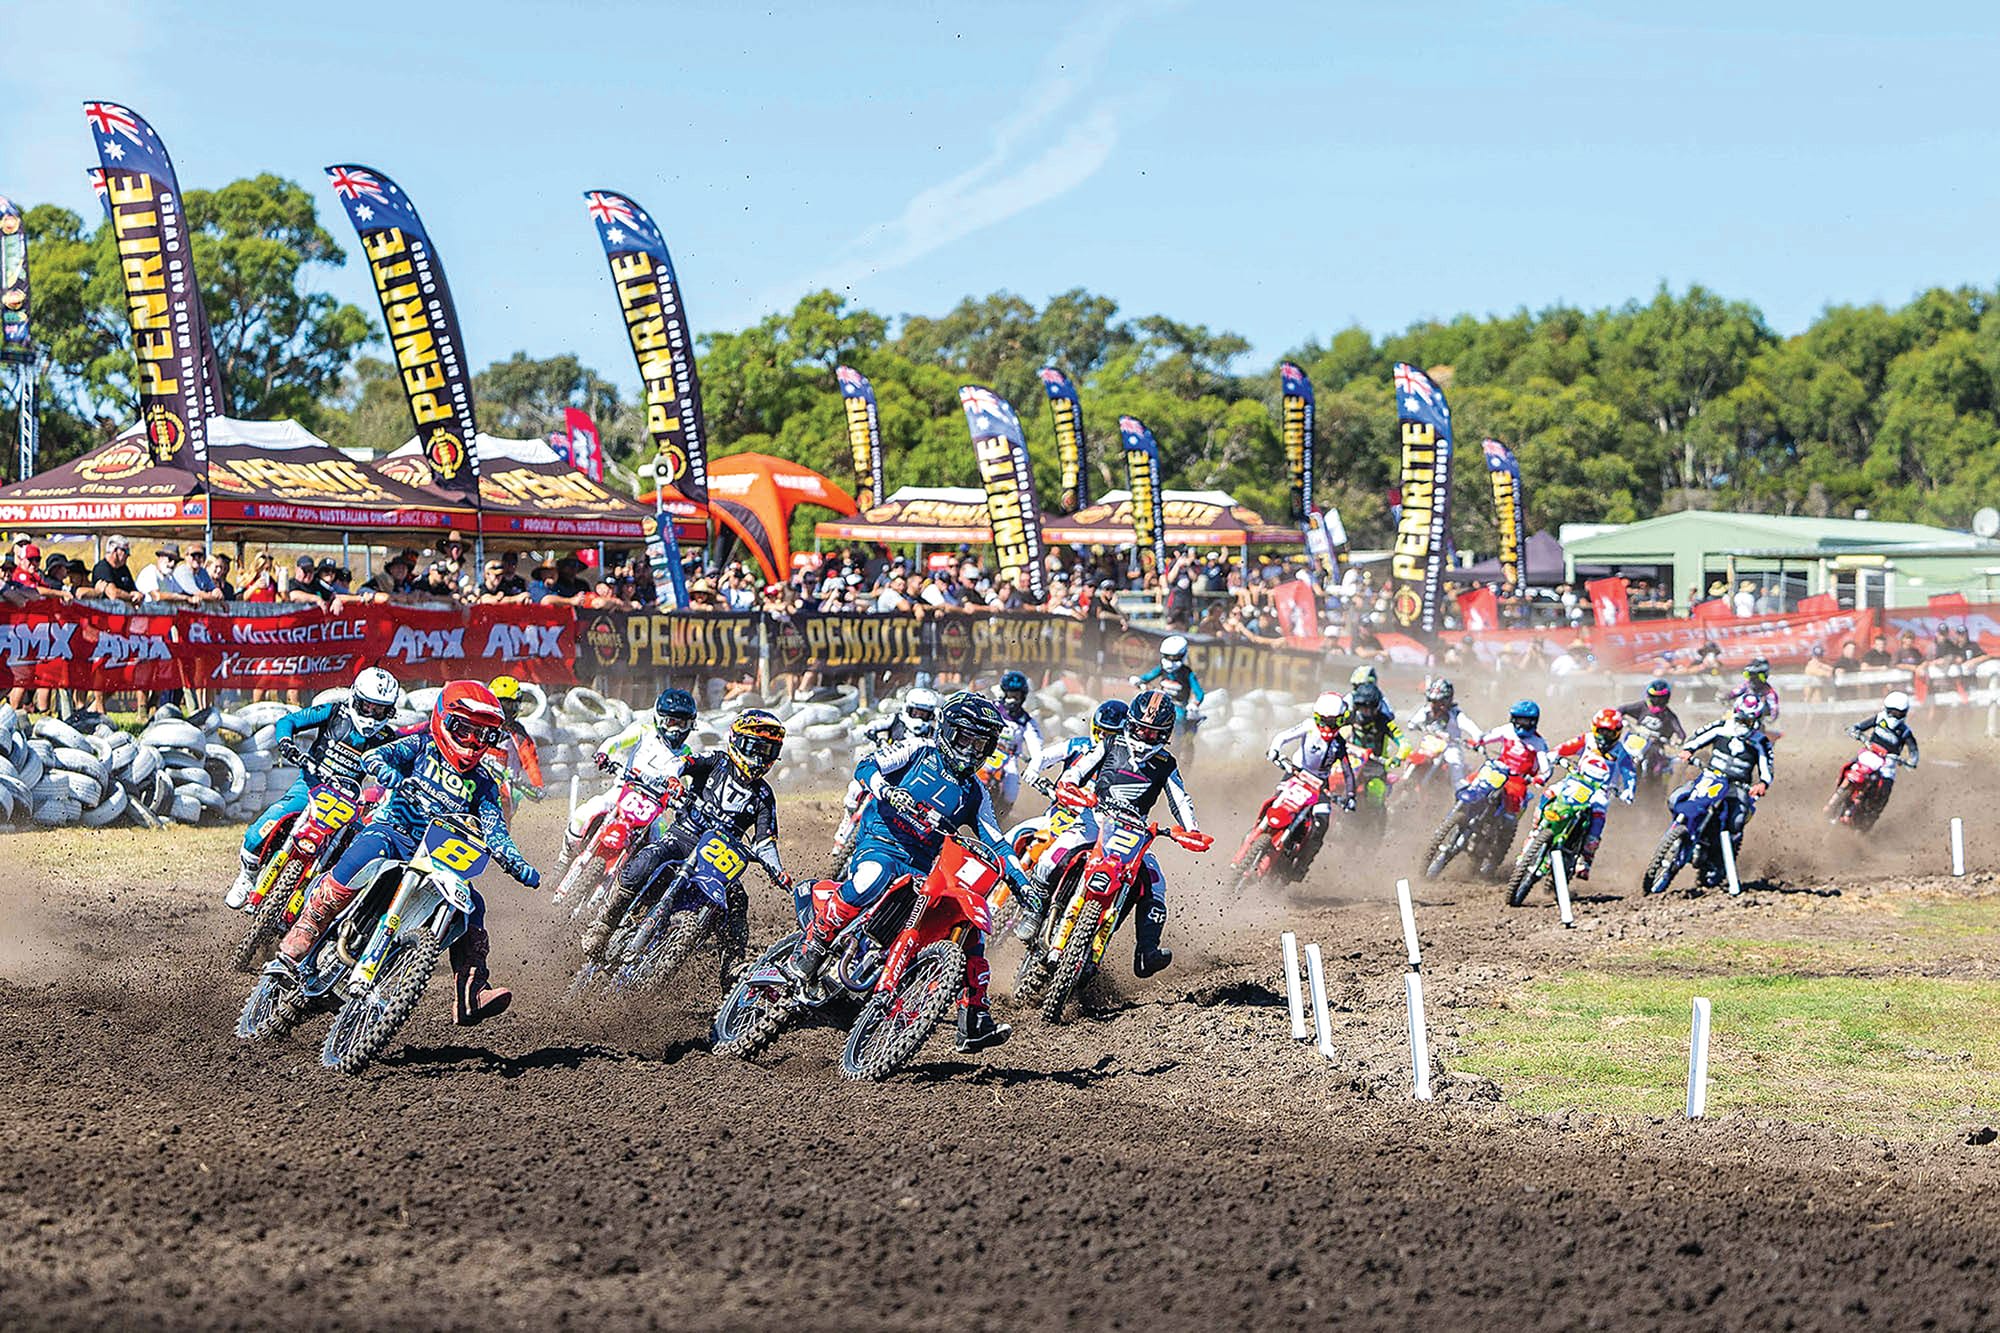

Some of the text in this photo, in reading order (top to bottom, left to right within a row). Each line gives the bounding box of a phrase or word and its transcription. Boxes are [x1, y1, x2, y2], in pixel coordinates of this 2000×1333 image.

[108, 172, 178, 395] PENRITE
[161, 193, 207, 461] AUSTRALIAN MADE AND OWNED
[363, 227, 453, 425] PENRITE
[612, 252, 680, 433] PENRITE
[411, 241, 480, 476] AUSTRALIAN MADE AND OWNED
[656, 265, 705, 486] AUSTRALIAN MADE AND OWNED
[30, 504, 122, 520] AUSTRALIAN
[124, 503, 177, 518] OWNED
[1393, 423, 1435, 581] PENRITE
[0, 622, 78, 668] AMX
[232, 618, 367, 645] MOTORCYCLE
[386, 625, 465, 664] AMX
[482, 624, 566, 662] AMX
[627, 615, 751, 667] PENRITE
[806, 617, 923, 666] PENRITE
[972, 619, 1085, 665] PENRITE
[1189, 645, 1312, 691] ENRITE
[423, 755, 477, 802] THOR
[315, 792, 356, 829] 22
[431, 838, 481, 872] 8
[700, 838, 746, 881] 261
[1105, 829, 1140, 855] 2
[955, 856, 988, 886] 1
